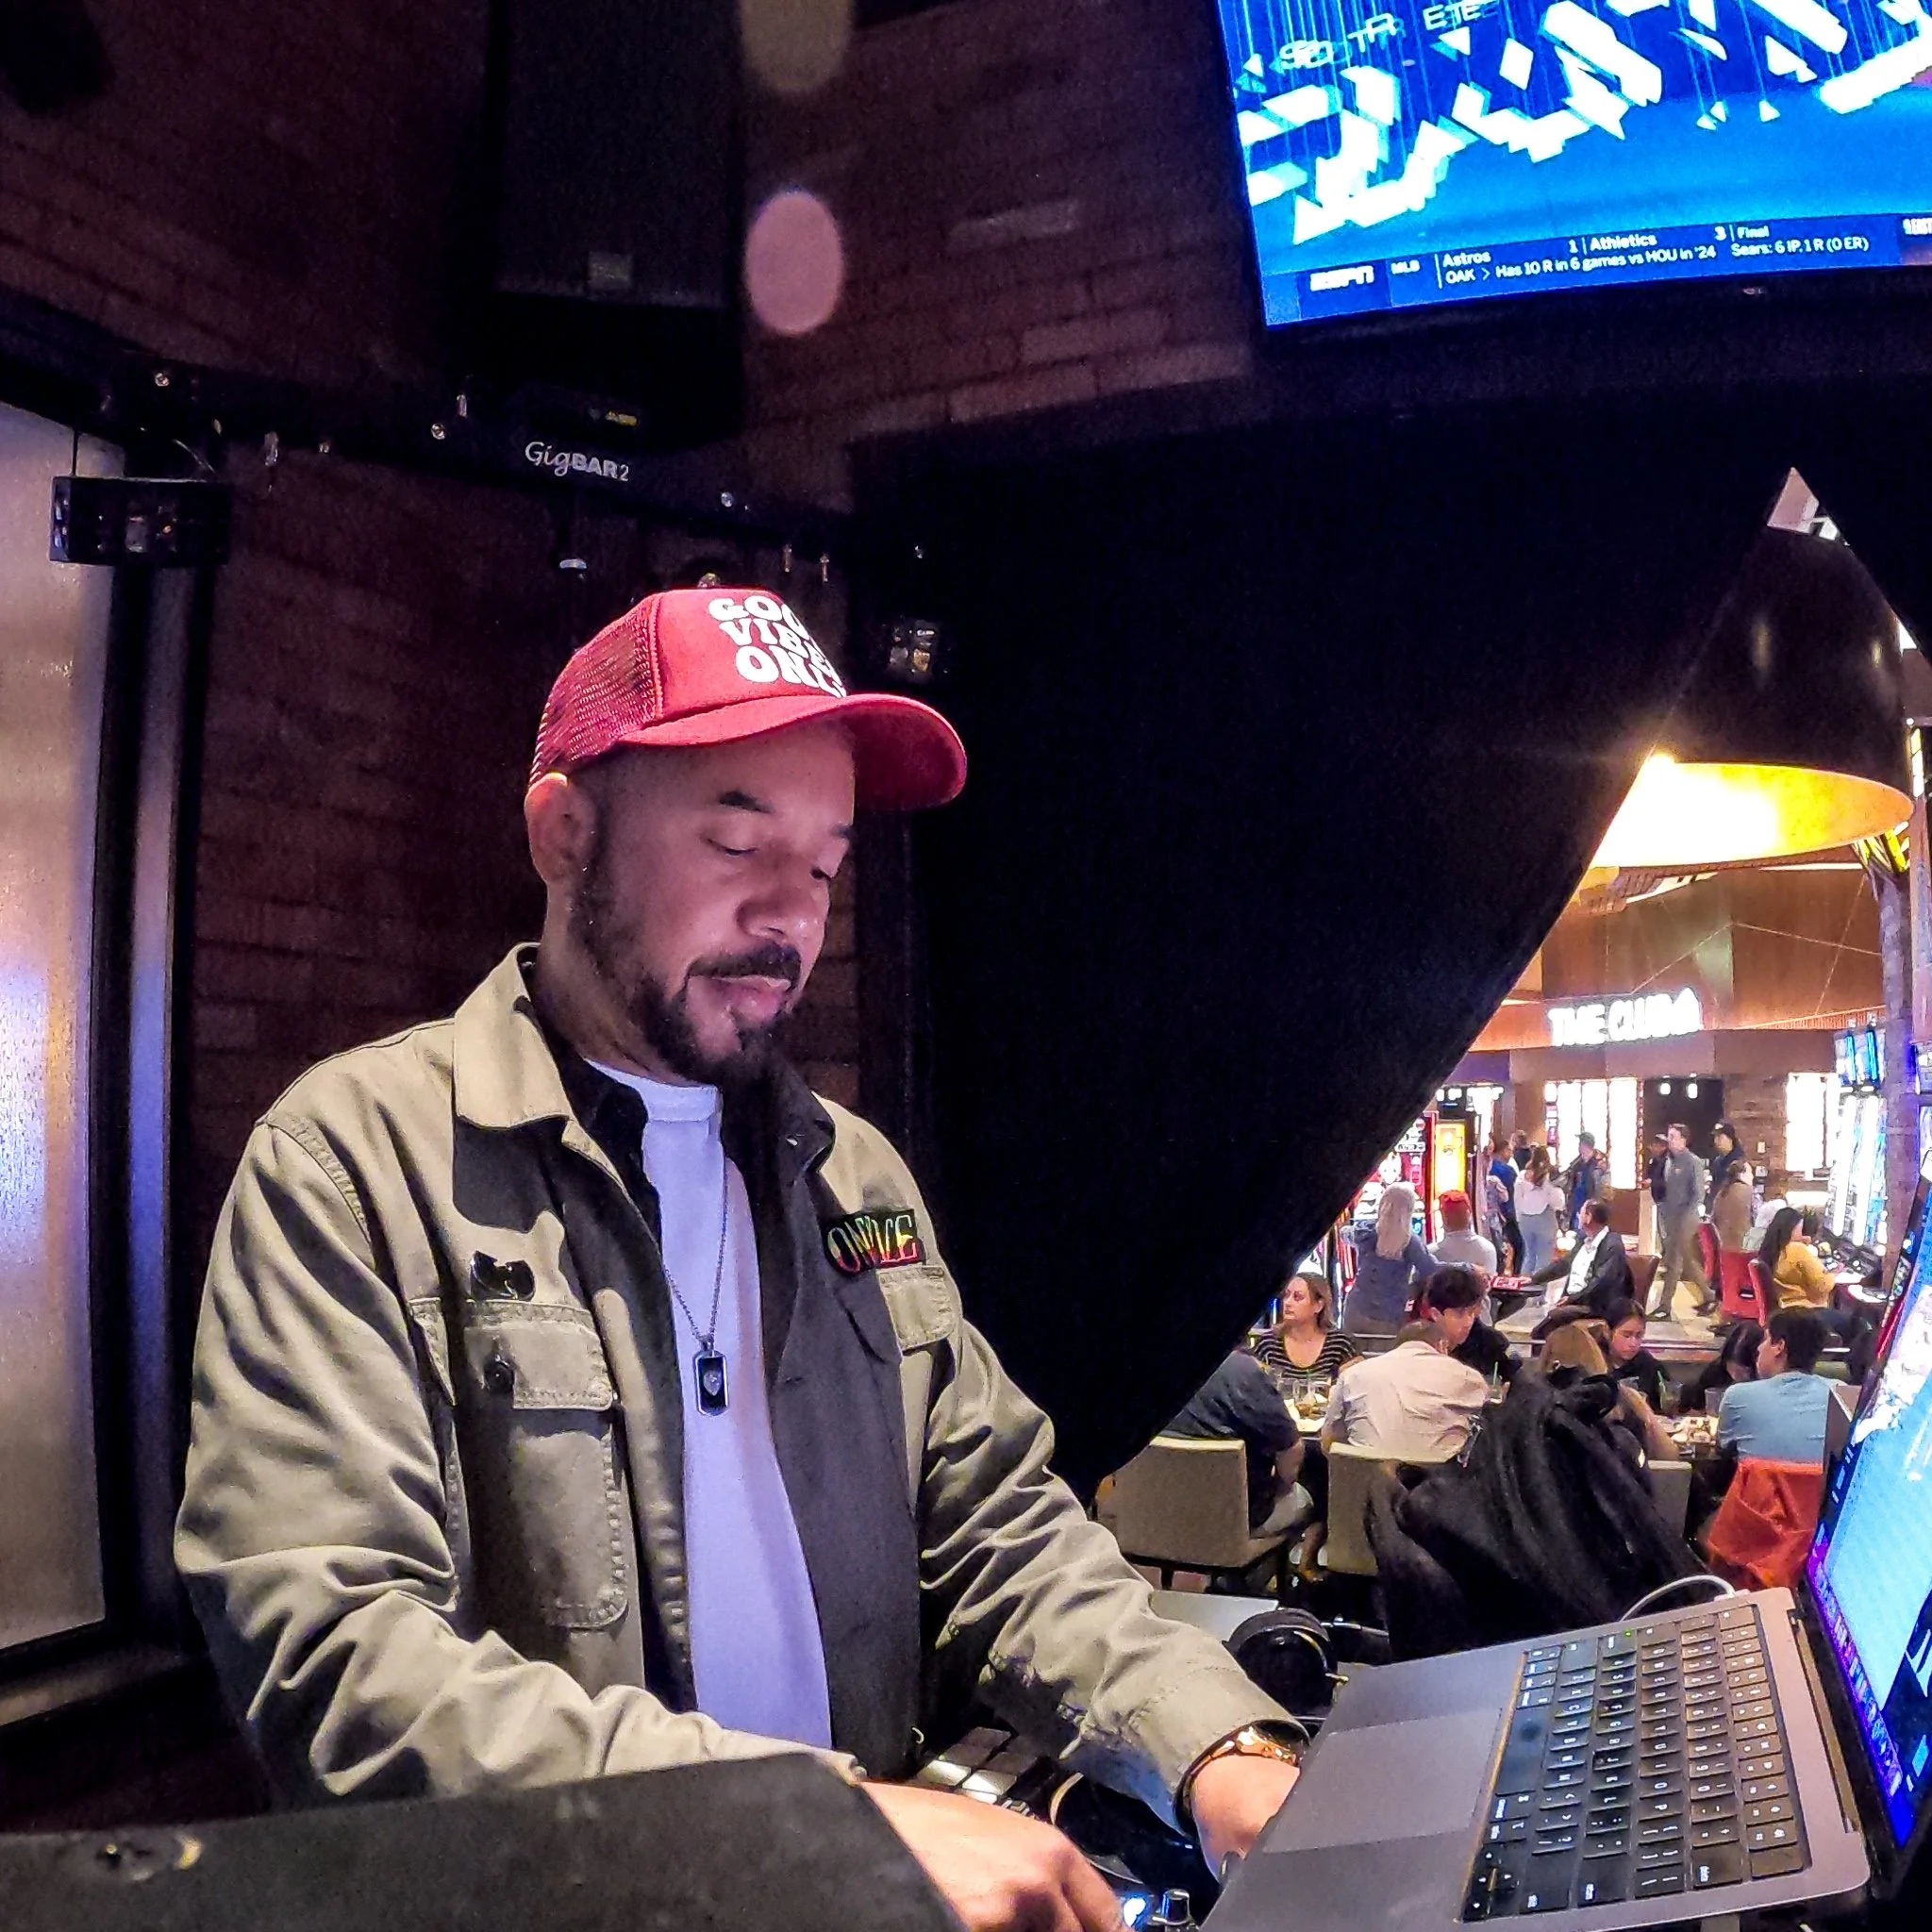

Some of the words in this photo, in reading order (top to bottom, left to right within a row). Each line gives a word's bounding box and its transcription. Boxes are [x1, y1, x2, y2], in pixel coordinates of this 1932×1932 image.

[1569, 239, 1578, 254] 1
[1590, 233, 1657, 252] Athletics
[1714, 225, 1727, 241] 3
[1737, 225, 1770, 240] Final
[1391, 259, 1420, 275] MLB
[1443, 251, 1491, 268] Astros
[1445, 268, 1476, 285] OAK
[1495, 264, 1523, 279] Has
[1524, 261, 1541, 275] 10
[1542, 259, 1554, 274] R
[1556, 258, 1569, 272] in
[1570, 256, 1580, 271] 6
[1582, 254, 1627, 273] games
[1628, 253, 1644, 265] vs
[1645, 248, 1677, 264] HOU
[1680, 247, 1693, 261] in
[1731, 242, 1774, 258] Sears:
[1774, 239, 1786, 254] 6
[1814, 237, 1824, 252] R
[1844, 234, 1870, 253] ER)
[708, 595, 825, 658] GOO
